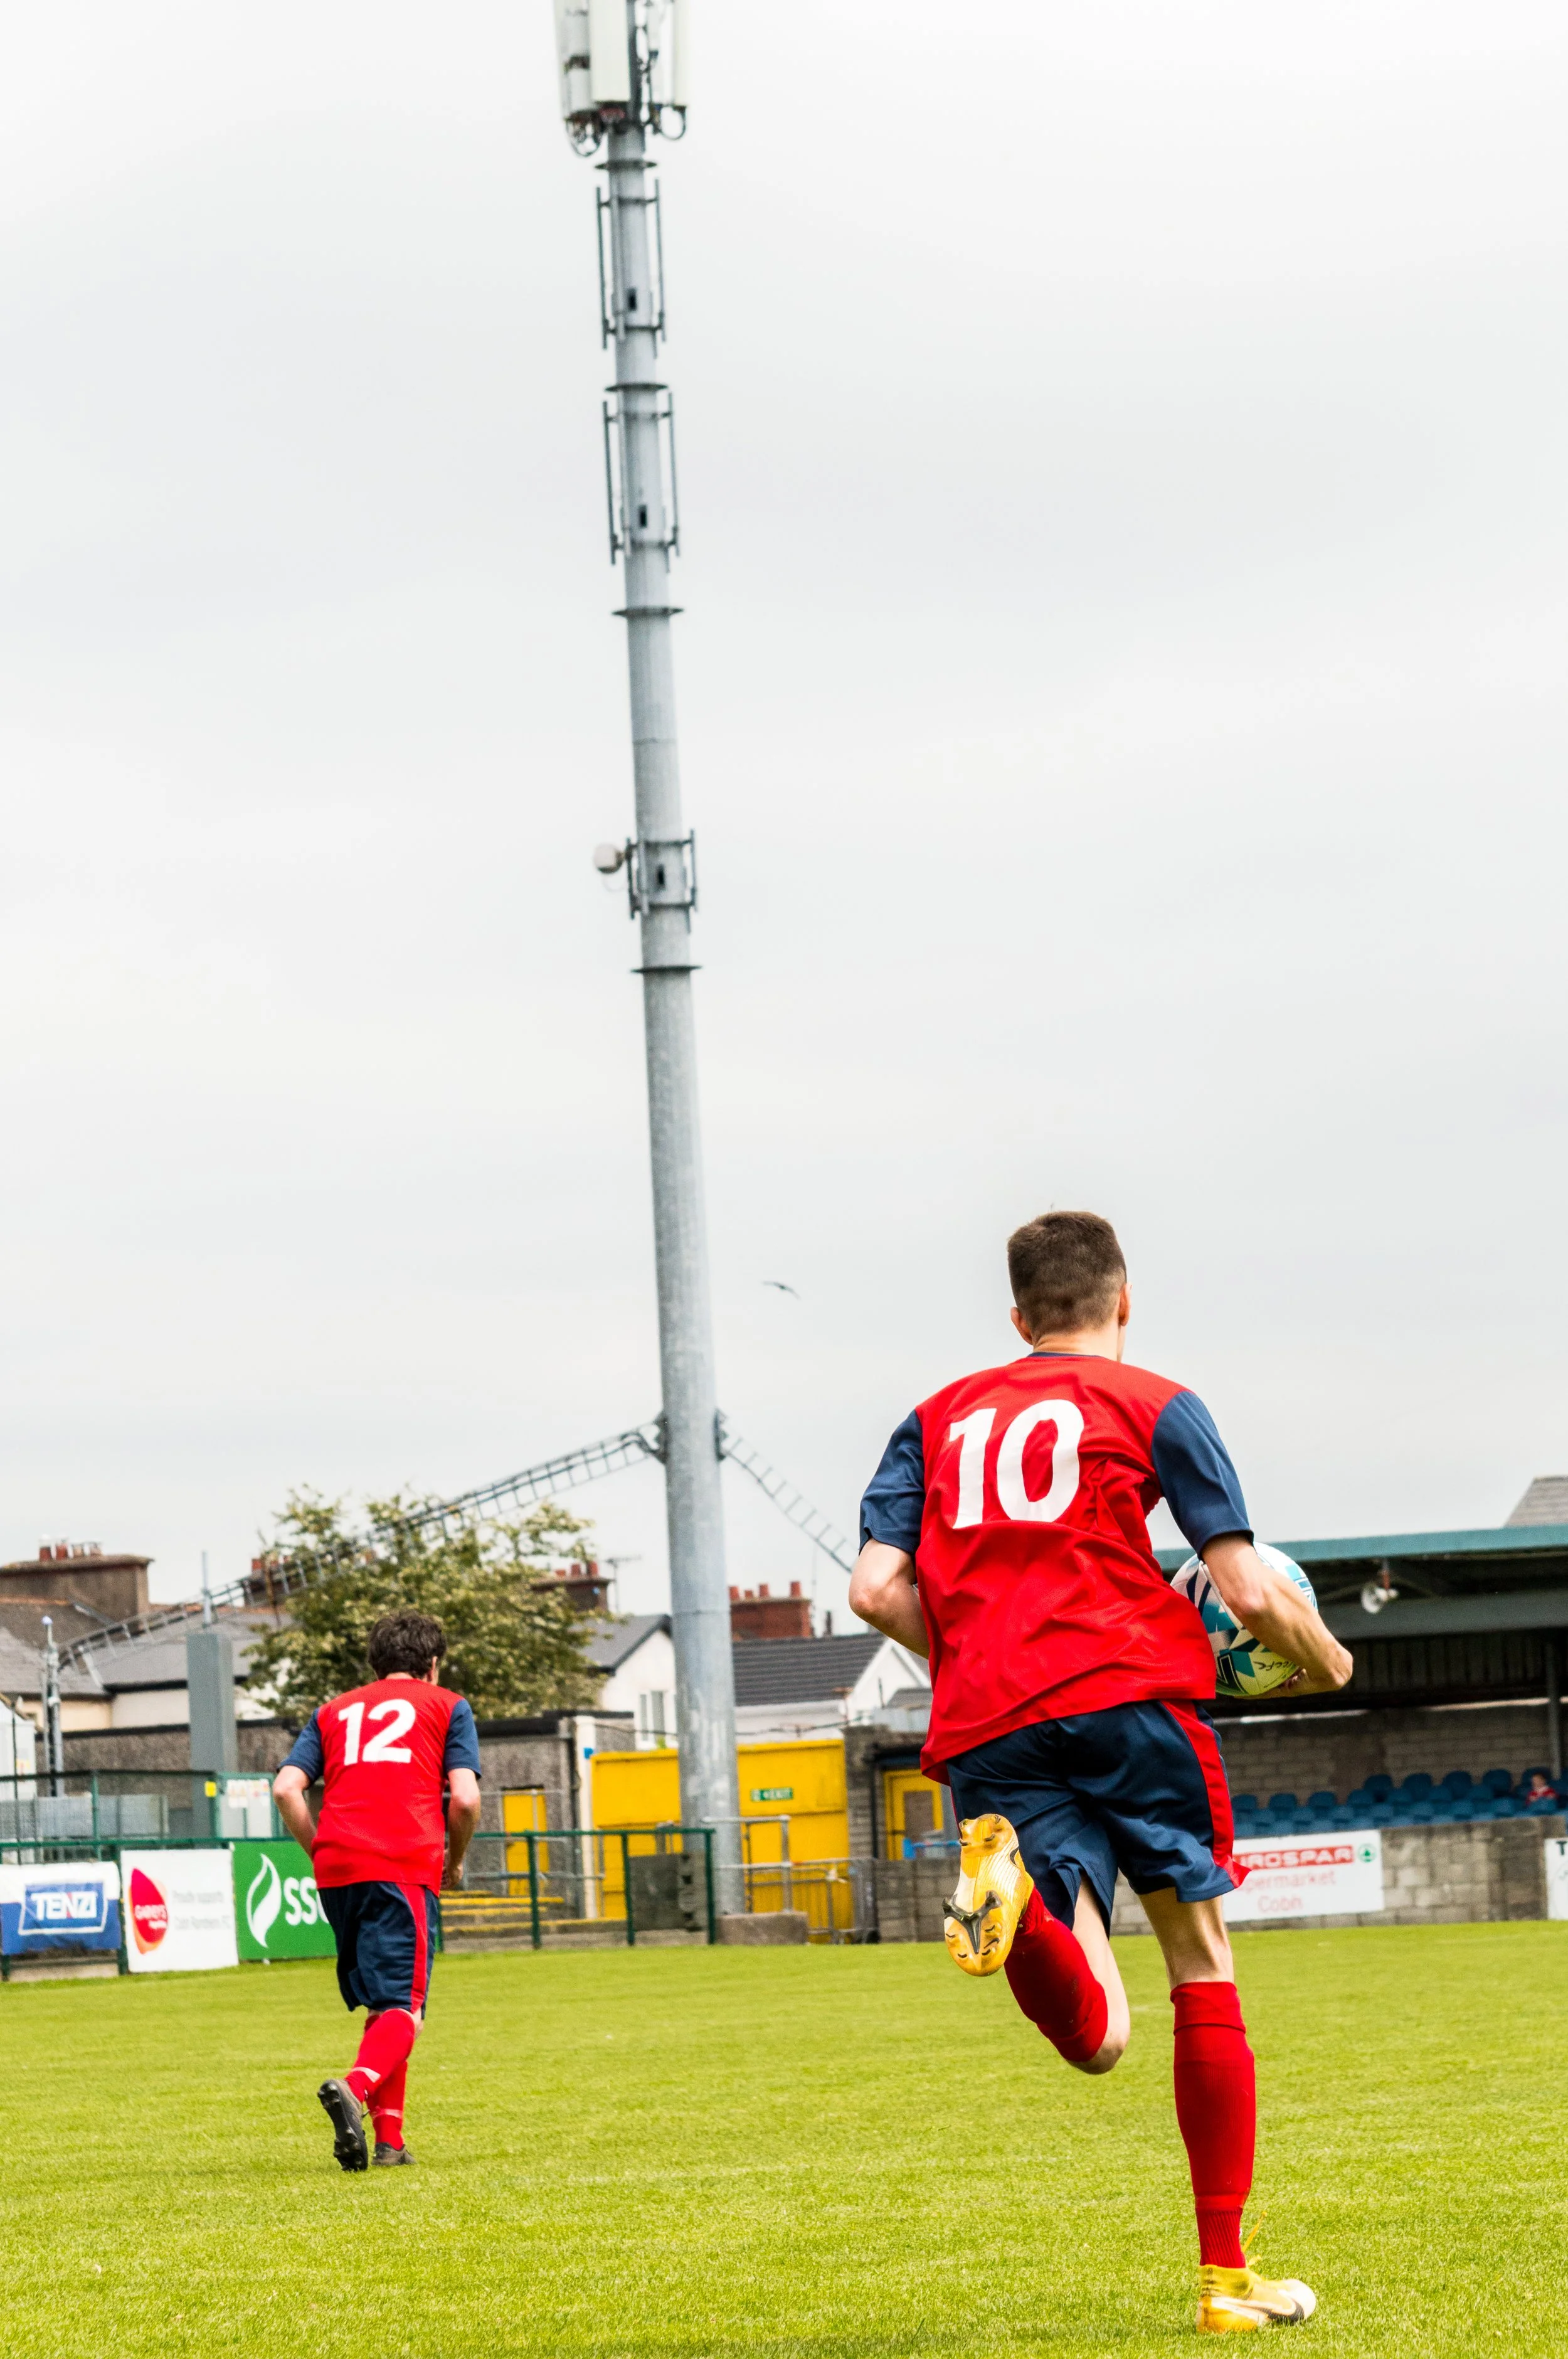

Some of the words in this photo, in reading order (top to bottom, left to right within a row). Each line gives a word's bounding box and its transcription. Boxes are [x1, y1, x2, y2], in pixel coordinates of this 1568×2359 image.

[949, 1399, 1084, 1529] 10
[338, 1699, 416, 1766] 12
[284, 1877, 329, 1925] SS
[1239, 1870, 1337, 1893] permarket
